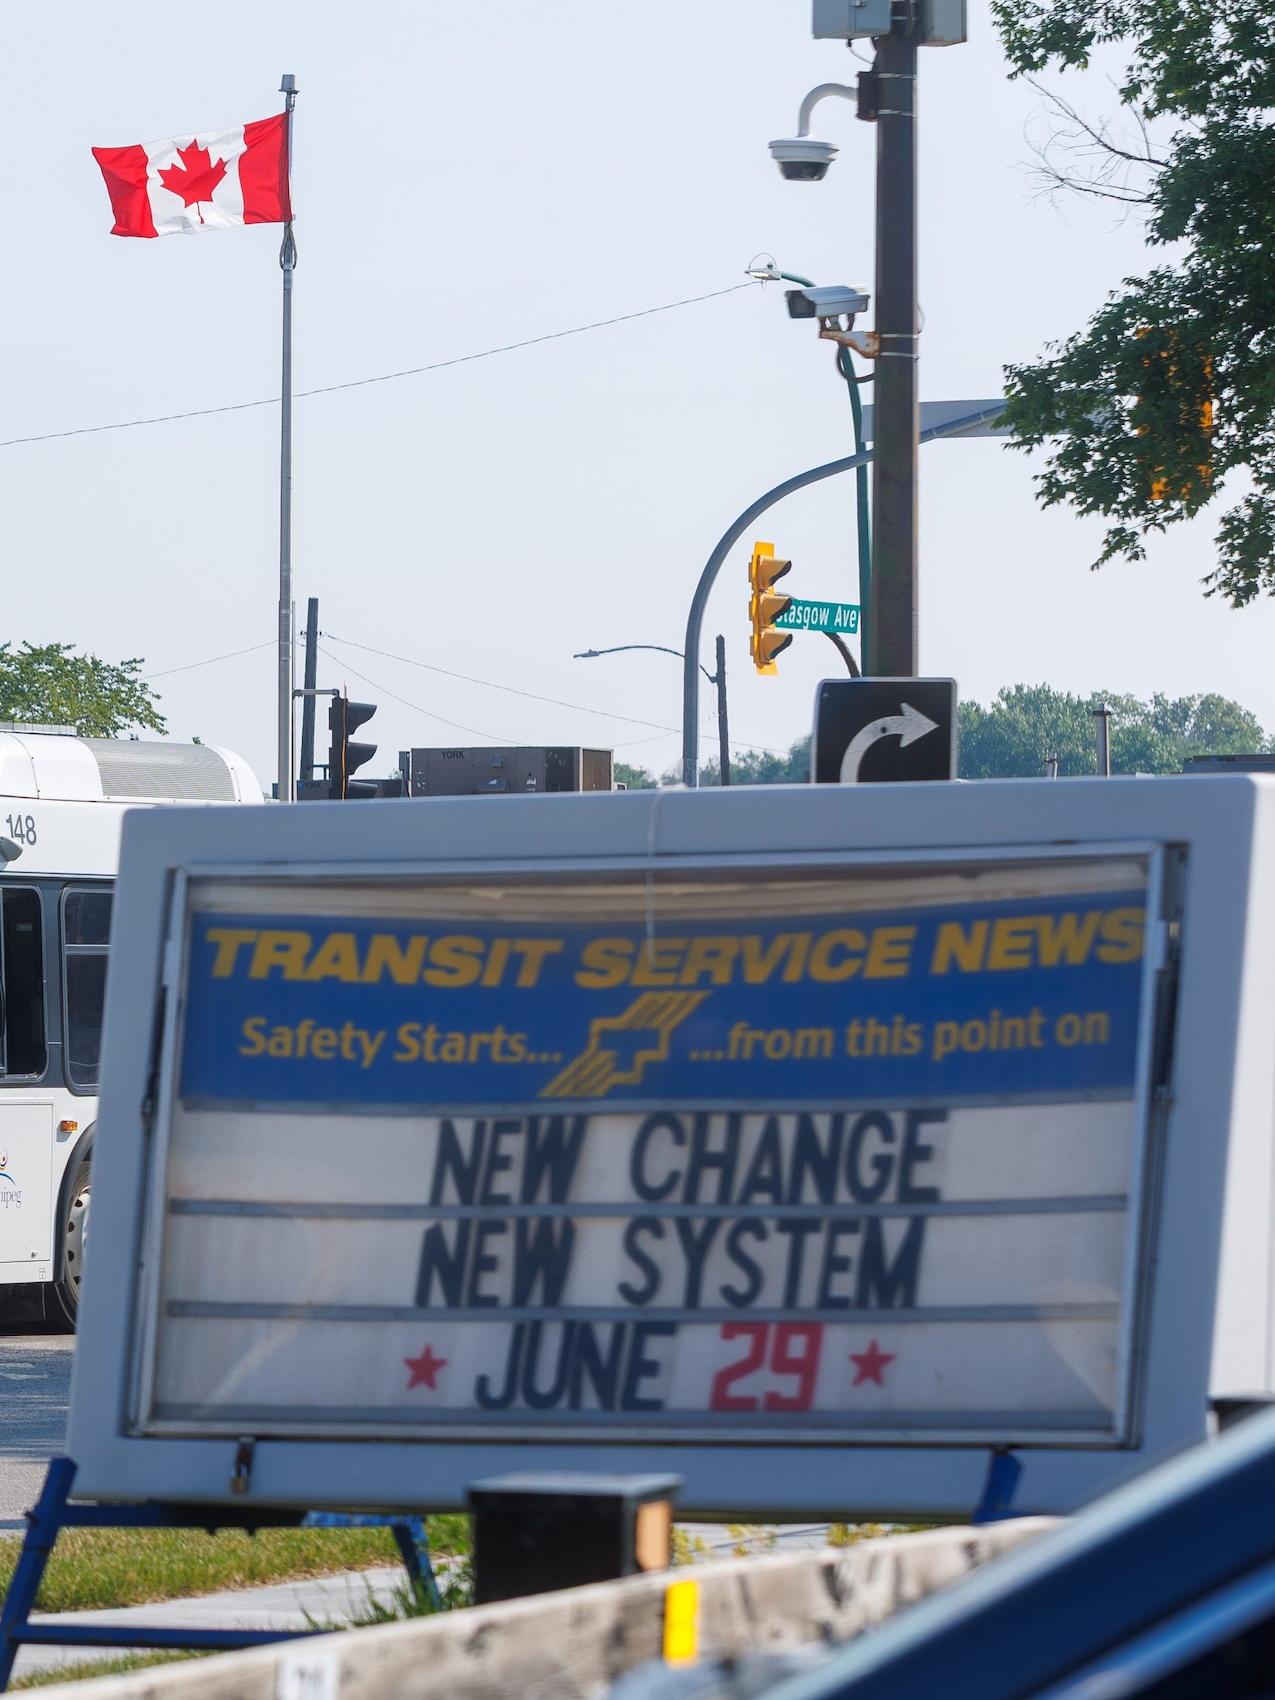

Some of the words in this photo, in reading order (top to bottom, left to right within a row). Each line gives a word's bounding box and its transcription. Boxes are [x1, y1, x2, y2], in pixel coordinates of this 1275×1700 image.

[776, 603, 830, 630] asgow
[834, 606, 857, 628] Ave
[441, 751, 465, 760] YORK
[5, 813, 37, 846] 148
[205, 926, 564, 988] TRANSIT
[574, 925, 917, 989] SERVICE
[930, 907, 1146, 975] NEWS
[239, 1016, 385, 1068] Safety
[846, 1015, 924, 1059] this
[932, 1007, 1048, 1063] point
[1055, 1010, 1111, 1047] on
[428, 1115, 589, 1206] NEW
[629, 1110, 948, 1204] CHANGE
[414, 1214, 577, 1308] NEW
[617, 1216, 928, 1308] SYSTEM
[474, 1320, 678, 1412] JUNE
[710, 1321, 824, 1412] 29
